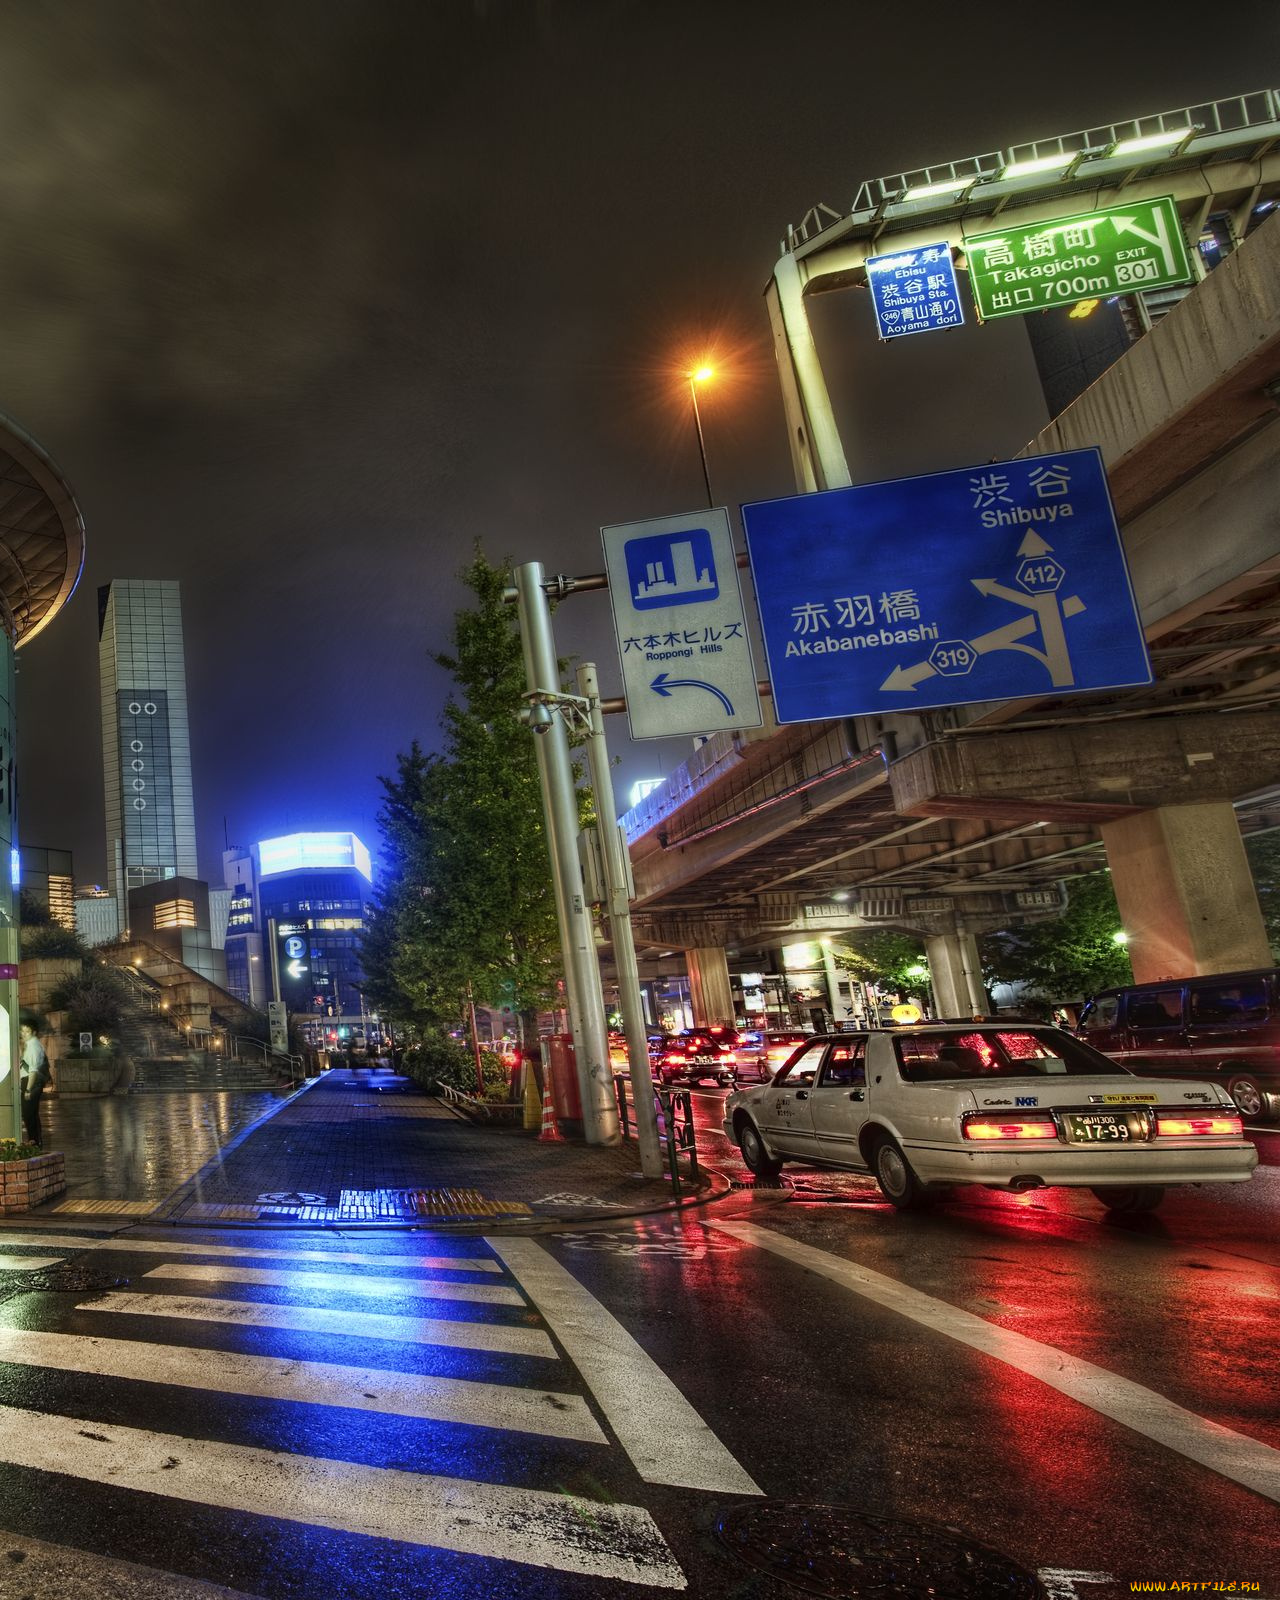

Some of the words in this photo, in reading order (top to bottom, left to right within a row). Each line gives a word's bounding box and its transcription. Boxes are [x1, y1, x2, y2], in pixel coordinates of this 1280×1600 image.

[983, 224, 1096, 269] 高樹町
[1116, 246, 1148, 261] EXIT
[895, 267, 927, 279] Ebisu
[987, 253, 1101, 285] Takagicho
[1118, 260, 1158, 283] 301
[881, 273, 948, 299] 渋谷駅
[992, 287, 1034, 310] 出口
[1040, 275, 1110, 299] 700m
[883, 294, 926, 308] Shibuya
[928, 289, 949, 299] Sta.
[883, 312, 898, 321] 246
[900, 299, 956, 322] 青山通り
[887, 320, 930, 334] Aoyama
[936, 314, 957, 325] dori
[969, 464, 1072, 508] 渋谷
[981, 501, 1074, 529] Shibuya
[1023, 563, 1058, 586] 412
[791, 588, 921, 635] 赤羽橋
[623, 623, 743, 653] 六本木ヒルズ
[785, 623, 940, 658] Akabanebashi
[646, 646, 694, 661] Roppongi
[700, 643, 723, 654] Hills
[936, 648, 969, 668] 319
[1085, 1124, 1129, 1139] 17-99
